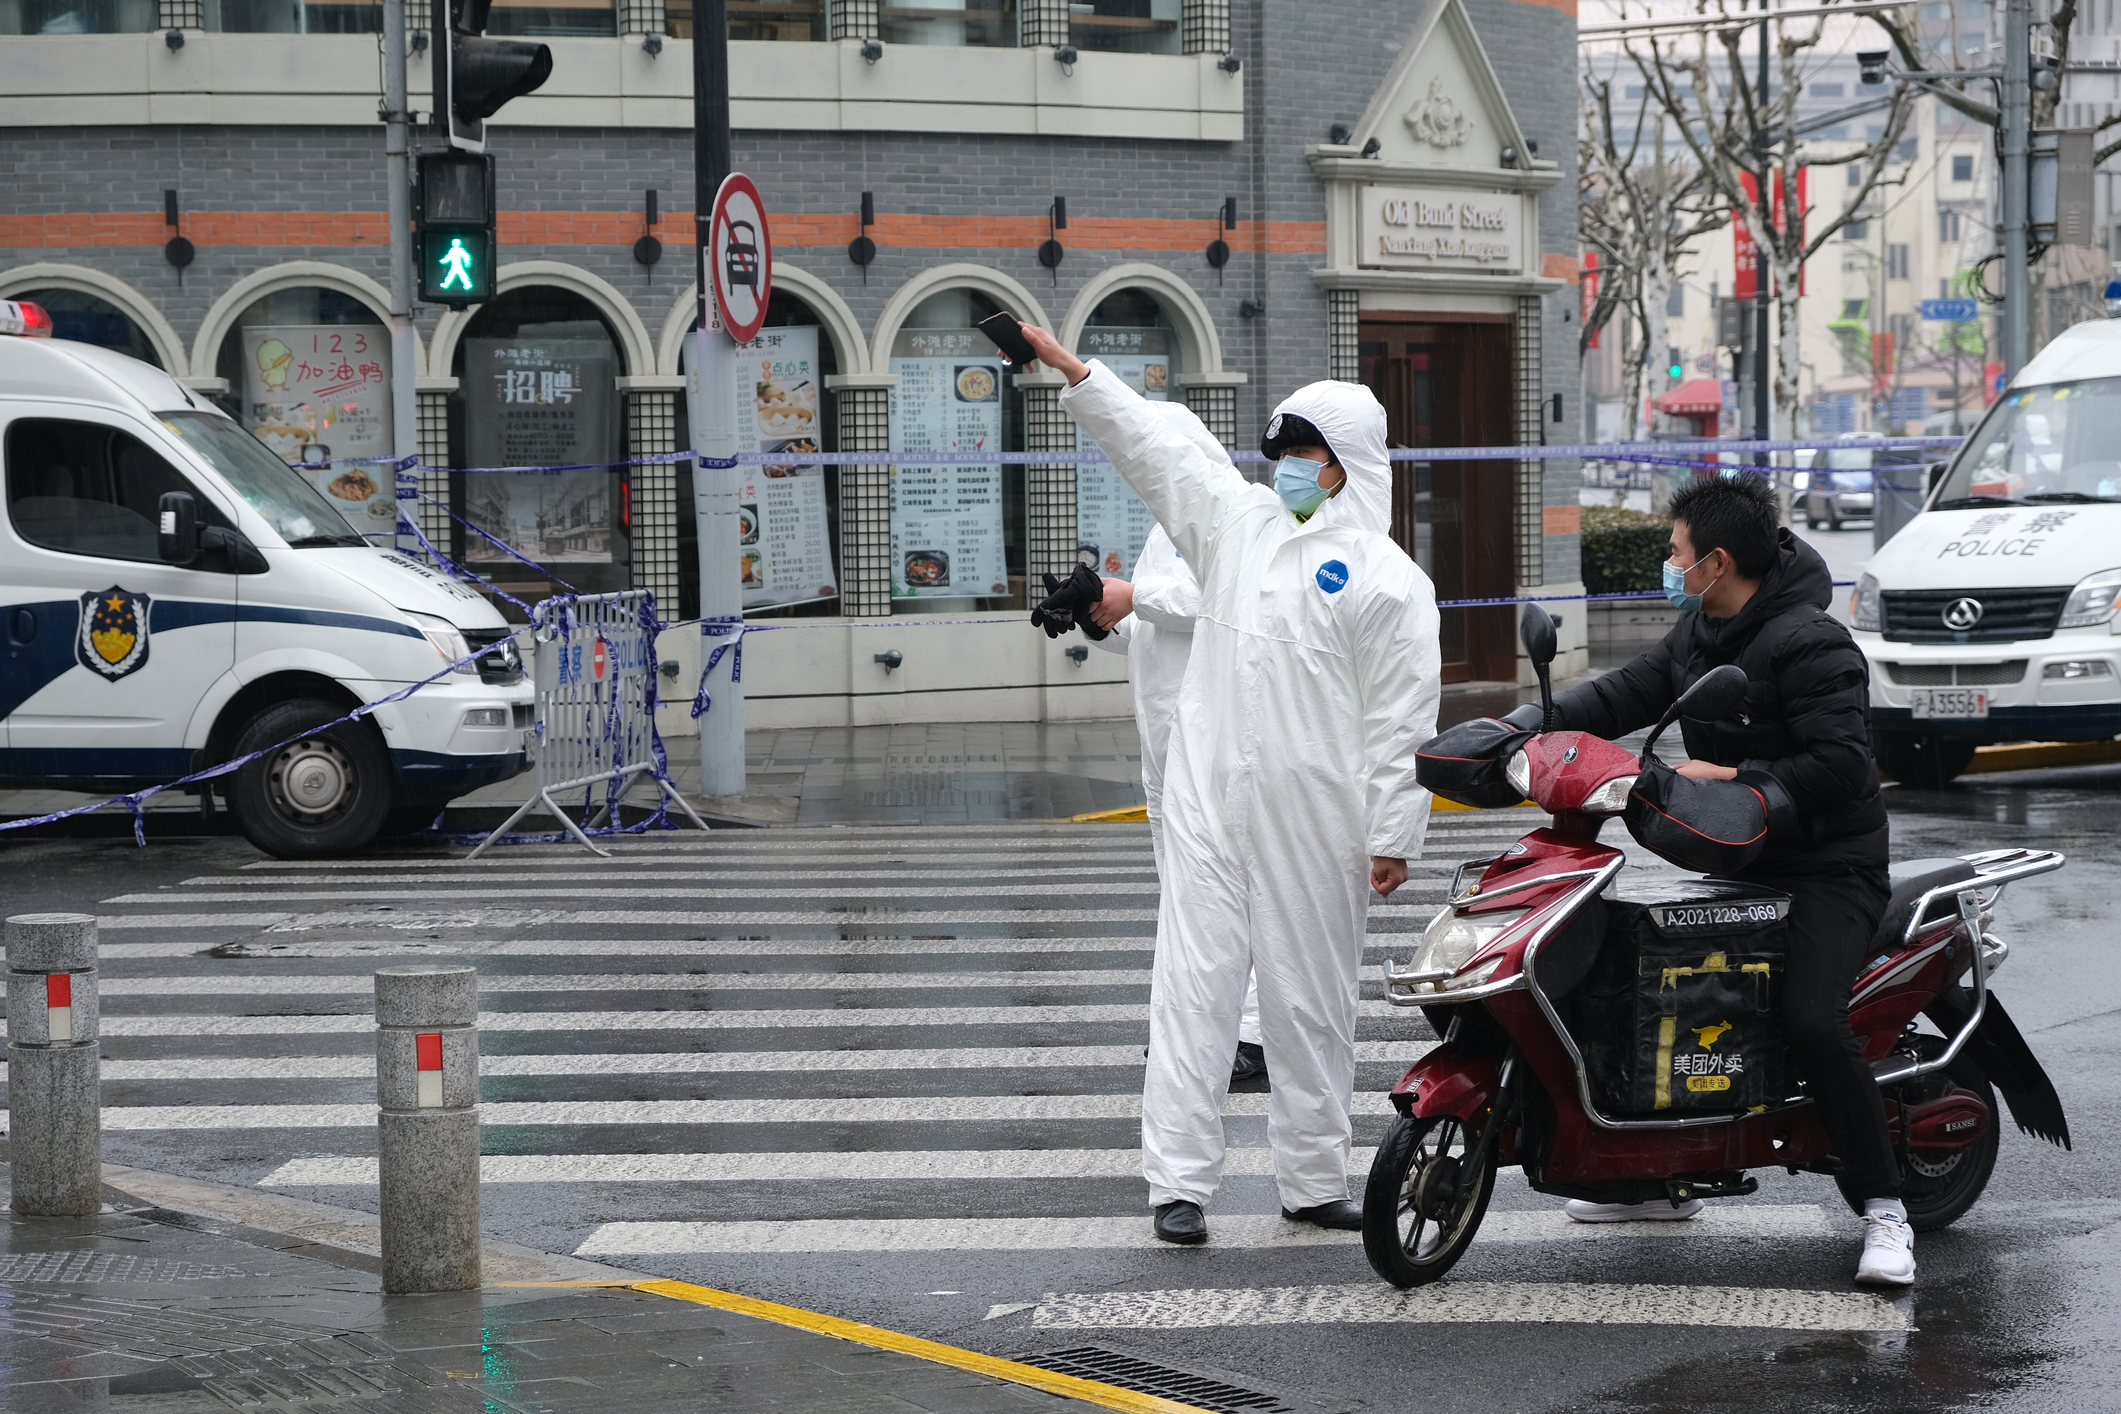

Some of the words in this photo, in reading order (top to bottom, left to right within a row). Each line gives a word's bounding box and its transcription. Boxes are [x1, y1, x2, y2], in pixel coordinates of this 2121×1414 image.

[1383, 199, 1409, 225] Old
[1415, 201, 1455, 227] Bund
[1461, 202, 1507, 230] Street
[912, 335, 972, 348] 外滩老街
[1090, 333, 1142, 346] 外滩老街
[494, 348, 544, 358] 外滩老街
[296, 356, 383, 383] 加油鸭
[772, 360, 810, 376] 点心类
[494, 369, 582, 404] 招聘
[1962, 511, 2078, 537] 警察
[1937, 539, 2045, 559] POLICE
[1667, 905, 1776, 926] A2021228-069
[1674, 1053, 1744, 1075] 美团外卖
[1692, 1078, 1726, 1089] 美团专送
